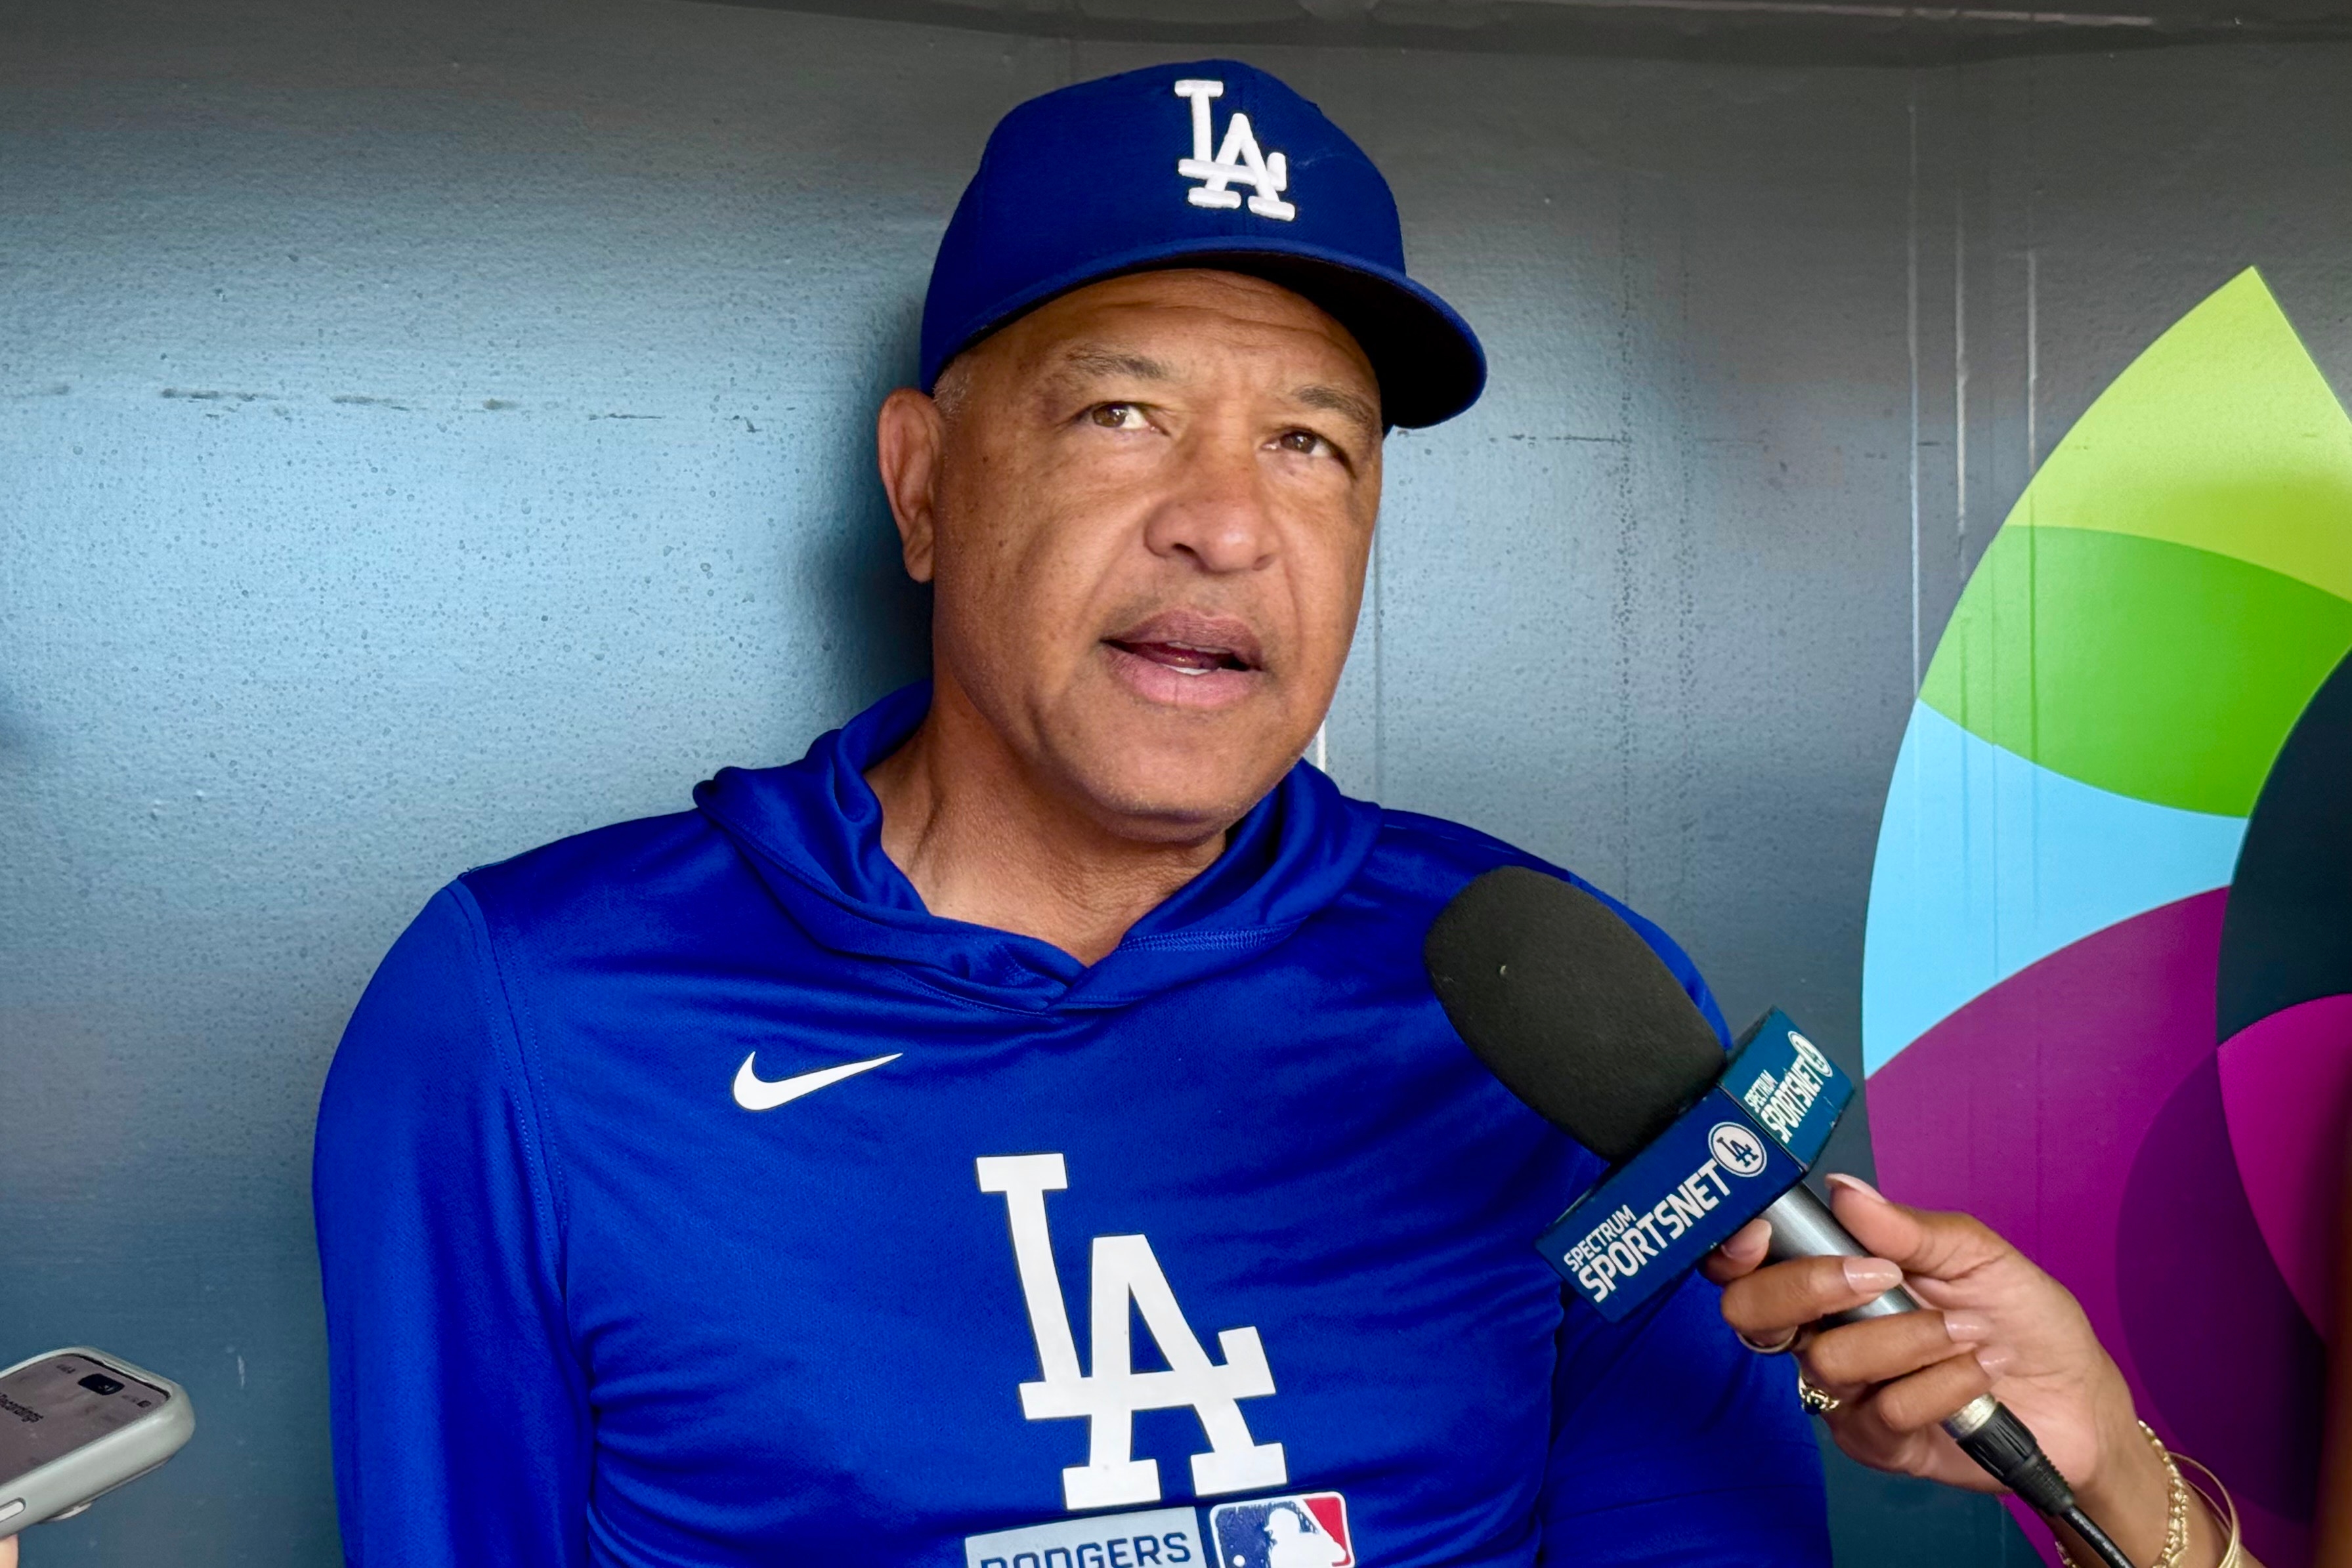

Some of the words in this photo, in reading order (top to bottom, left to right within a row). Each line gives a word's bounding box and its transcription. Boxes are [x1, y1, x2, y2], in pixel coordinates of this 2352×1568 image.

[1174, 79, 1295, 221] LA
[1743, 1069, 1778, 1113] SPECTRUM
[1761, 1053, 1824, 1144] SPORTSNET
[1716, 1136, 1760, 1168] LA
[1564, 1204, 1637, 1272] SPECTRUM
[1578, 1158, 1731, 1303] SPORTSNET
[976, 1153, 1288, 1510] LA
